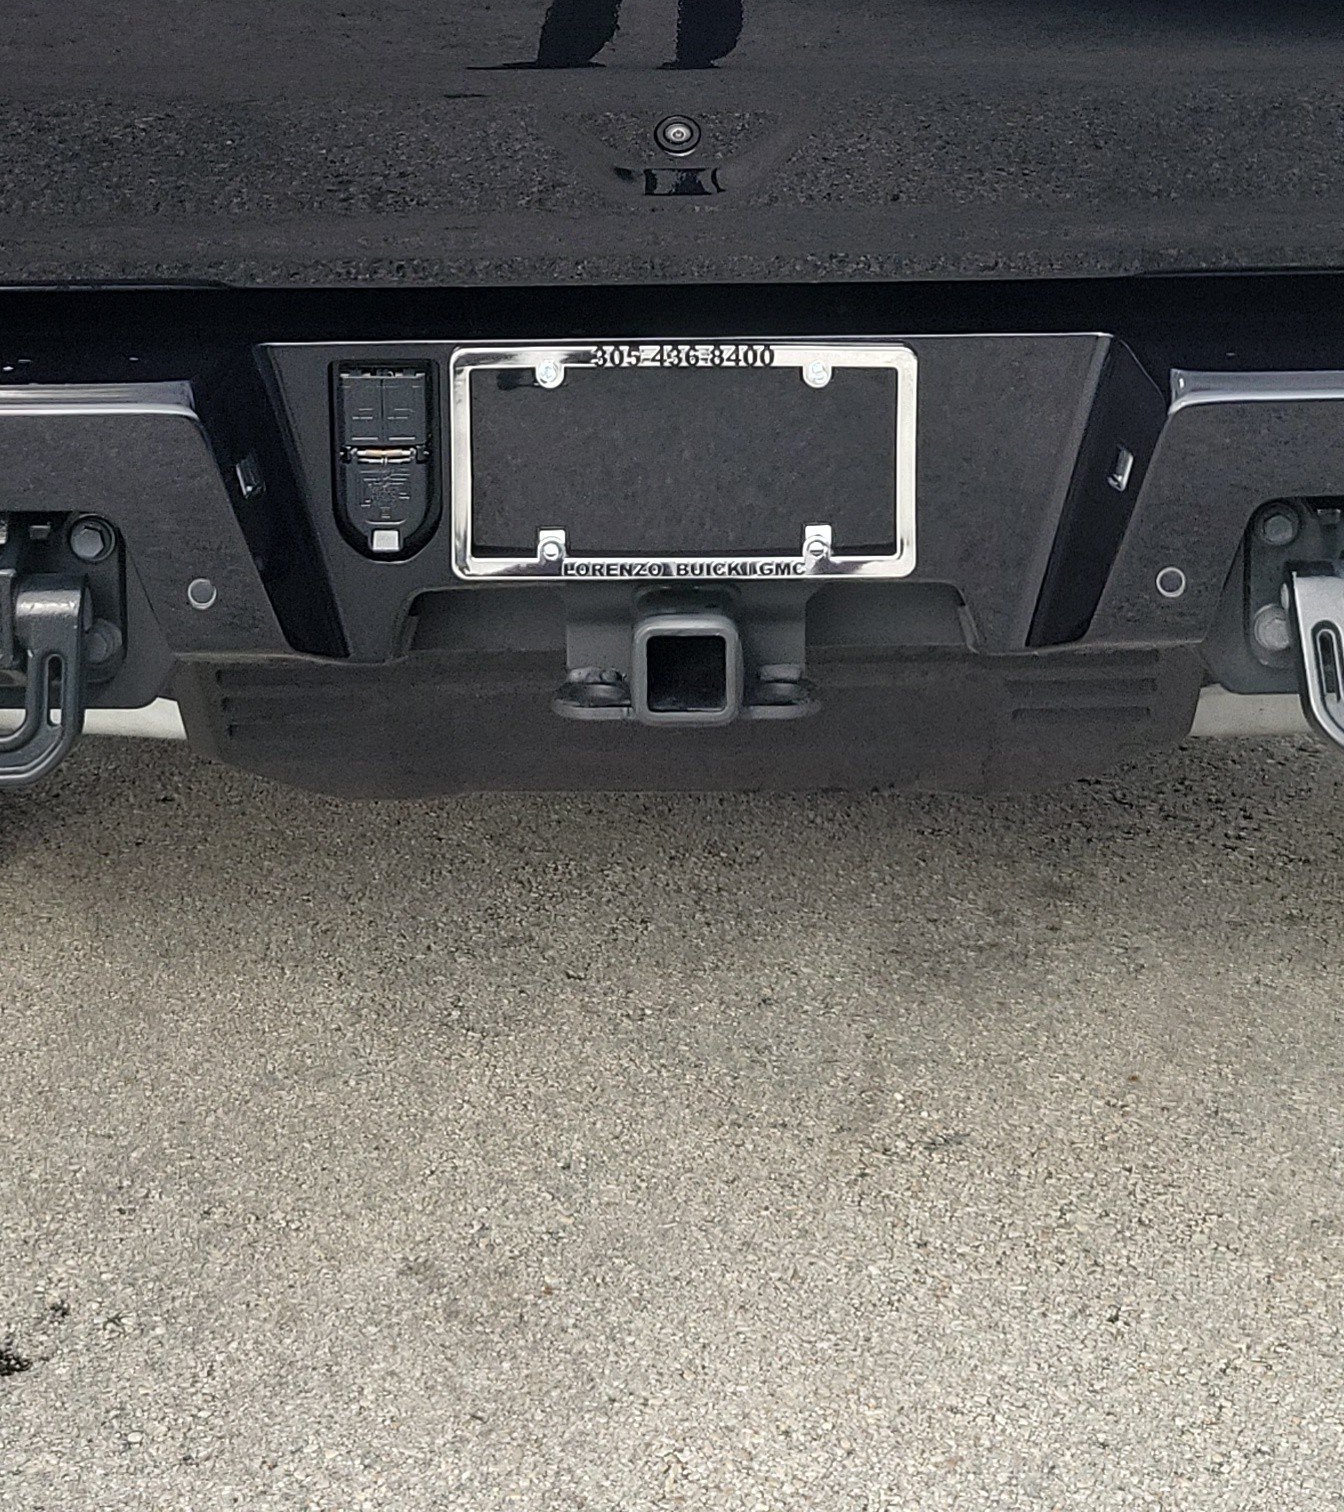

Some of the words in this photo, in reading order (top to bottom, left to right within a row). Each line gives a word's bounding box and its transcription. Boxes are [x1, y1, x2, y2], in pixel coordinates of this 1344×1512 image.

[590, 345, 775, 367] 305-436-8400
[563, 561, 663, 577] LORENZO
[676, 561, 744, 577] BUICK
[759, 561, 806, 576] GMC
